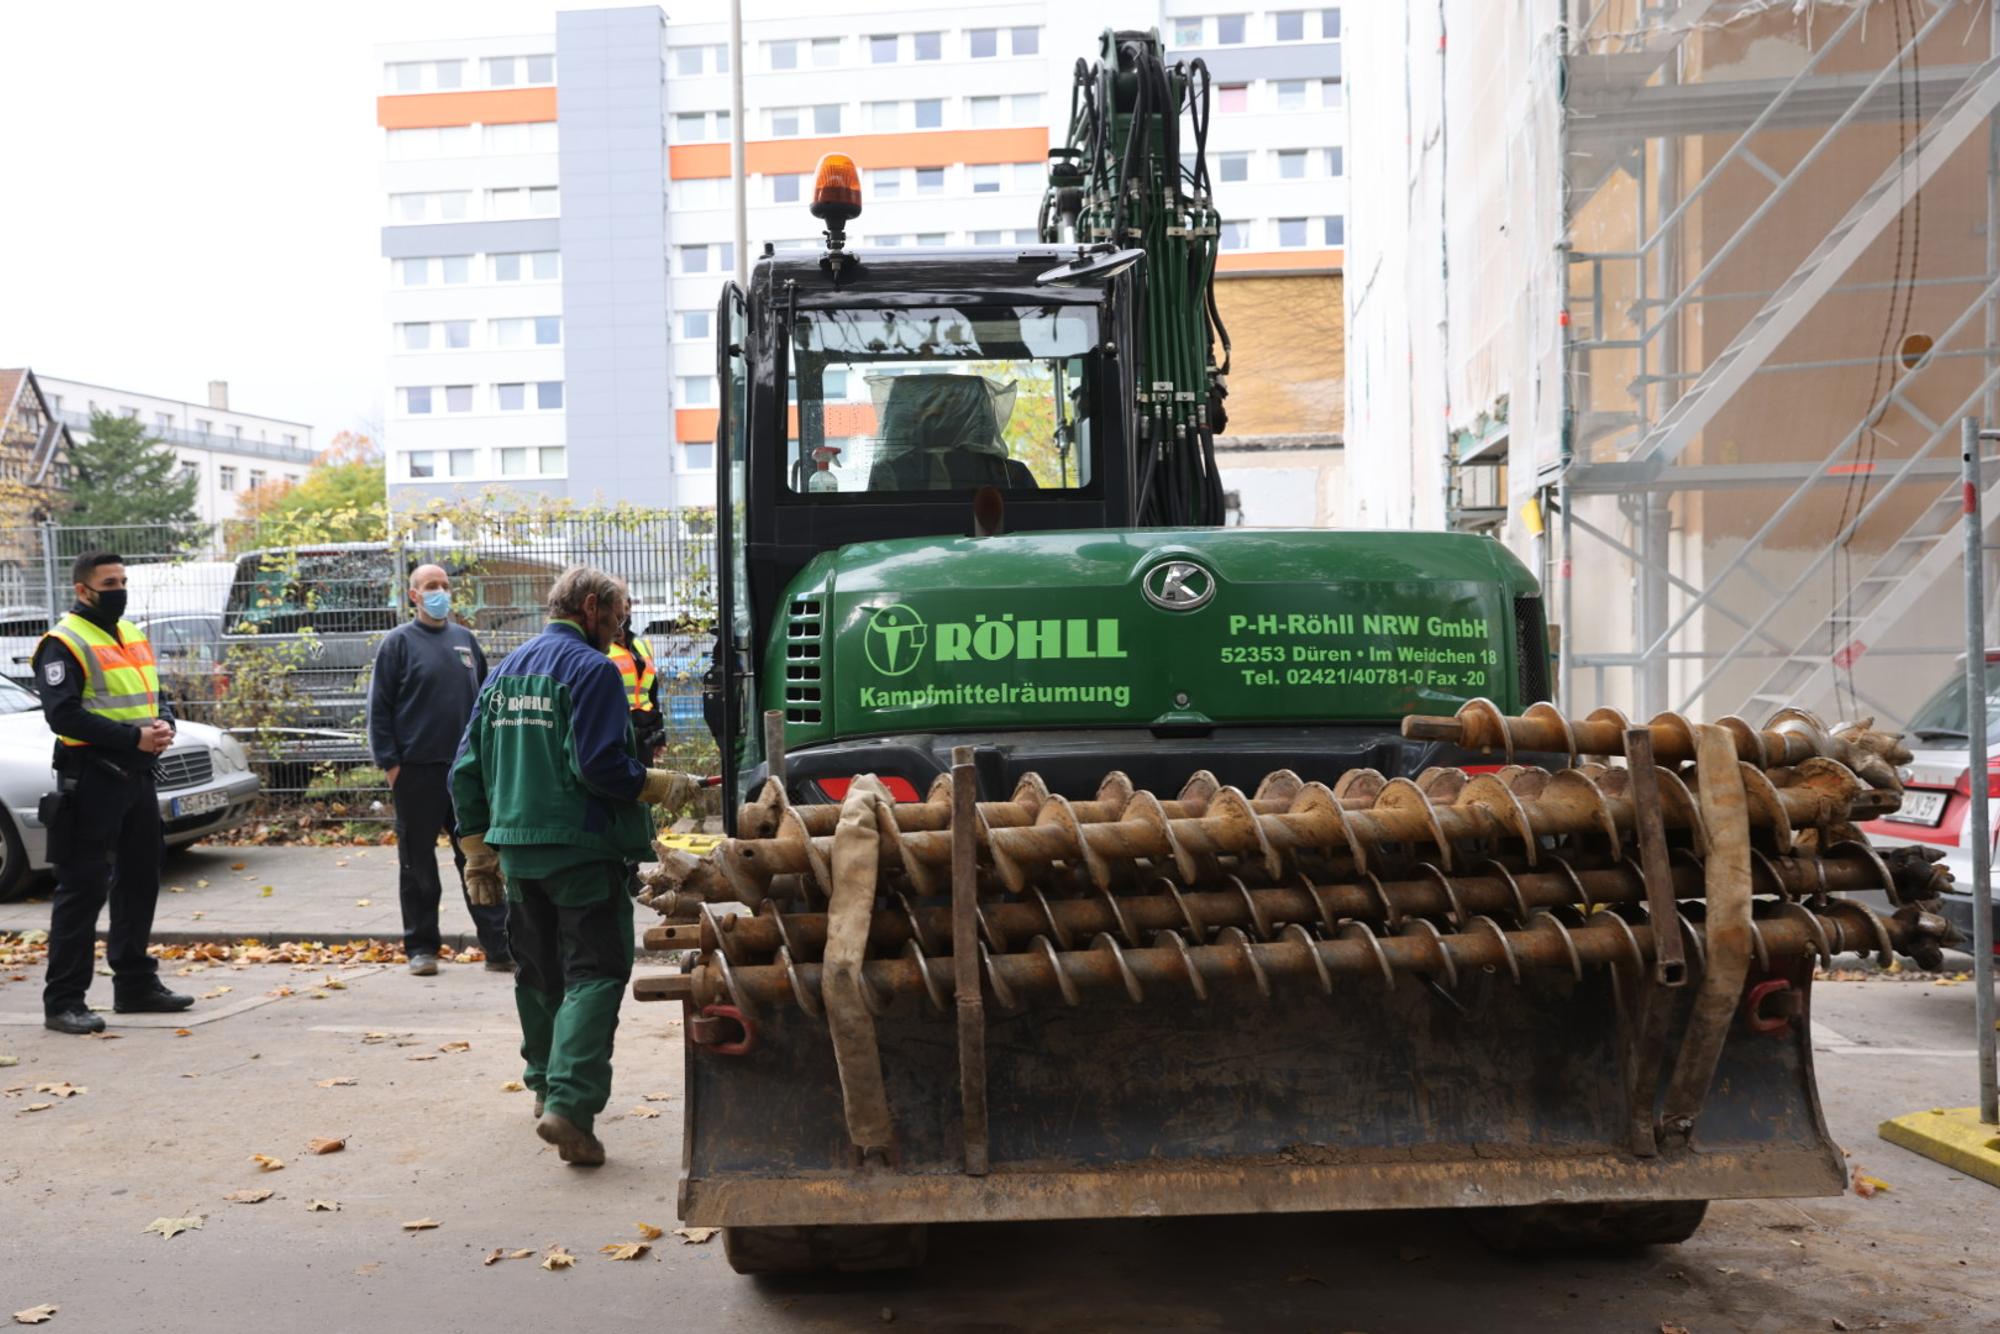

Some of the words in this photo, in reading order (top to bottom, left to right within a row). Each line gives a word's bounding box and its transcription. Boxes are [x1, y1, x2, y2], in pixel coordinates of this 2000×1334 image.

[936, 613, 1128, 661] RÖHLL
[1229, 614, 1354, 635] P-H-Röhll
[1363, 615, 1419, 636] NRW
[1427, 617, 1489, 638] GmbH
[1221, 647, 1286, 663] 52353
[1293, 647, 1351, 662] Düren
[1370, 647, 1392, 661] Im
[1399, 647, 1475, 664] Weidchen
[1480, 650, 1497, 665] 18
[1241, 670, 1280, 685] Tel.
[1286, 669, 1423, 684] 02421/40781-0
[1427, 670, 1457, 685] Fax
[1461, 671, 1485, 686] -20
[860, 683, 1131, 708] Kampfmittelräumung
